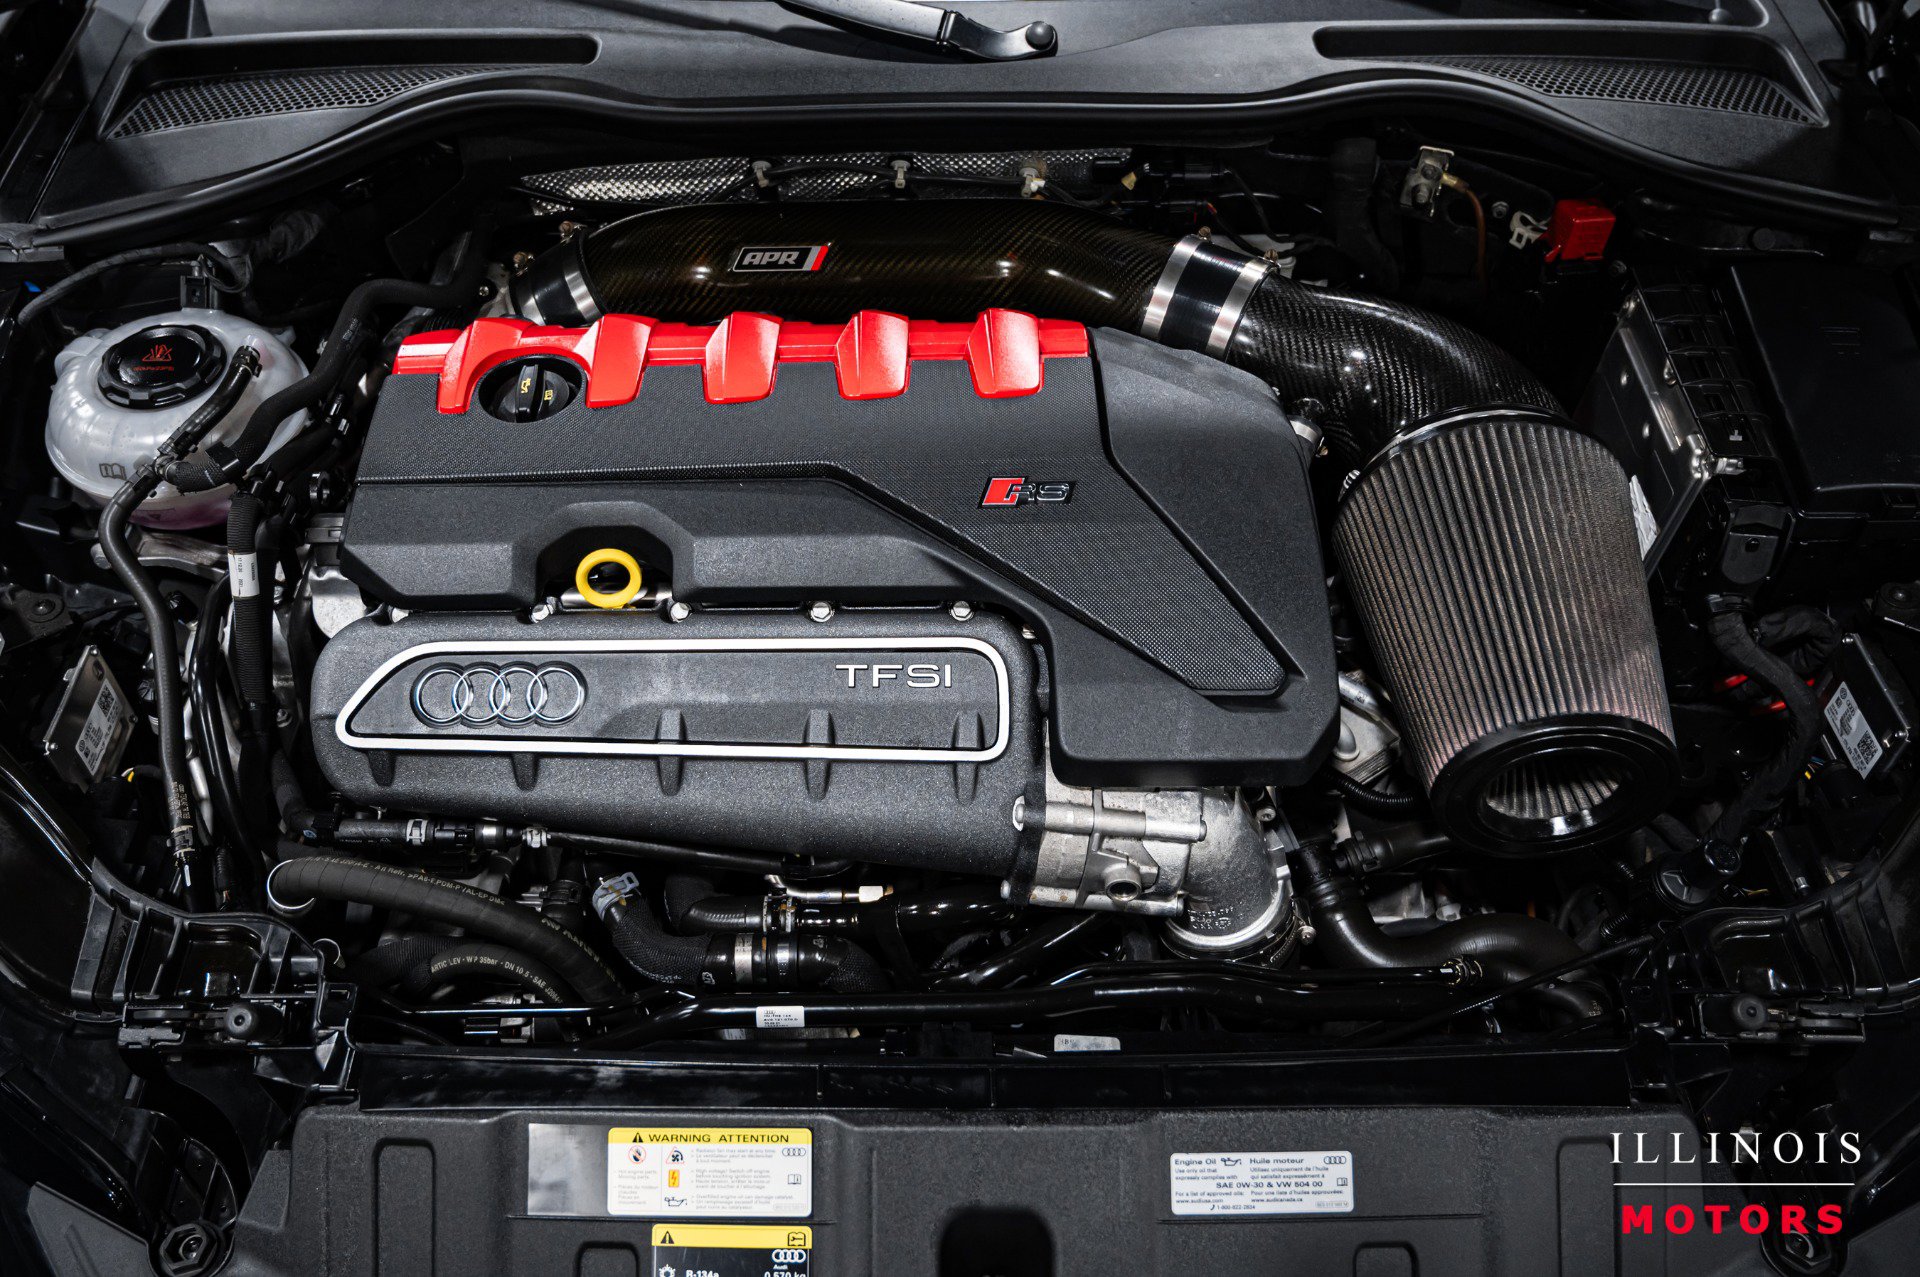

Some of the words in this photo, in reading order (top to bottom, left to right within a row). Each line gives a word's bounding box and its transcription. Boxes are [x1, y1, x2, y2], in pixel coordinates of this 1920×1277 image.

[742, 251, 800, 265] APR
[835, 664, 952, 688] TFSI
[649, 1134, 711, 1143] WARNING
[718, 1134, 789, 1143] ATTENTION
[1175, 1158, 1203, 1166] Engine
